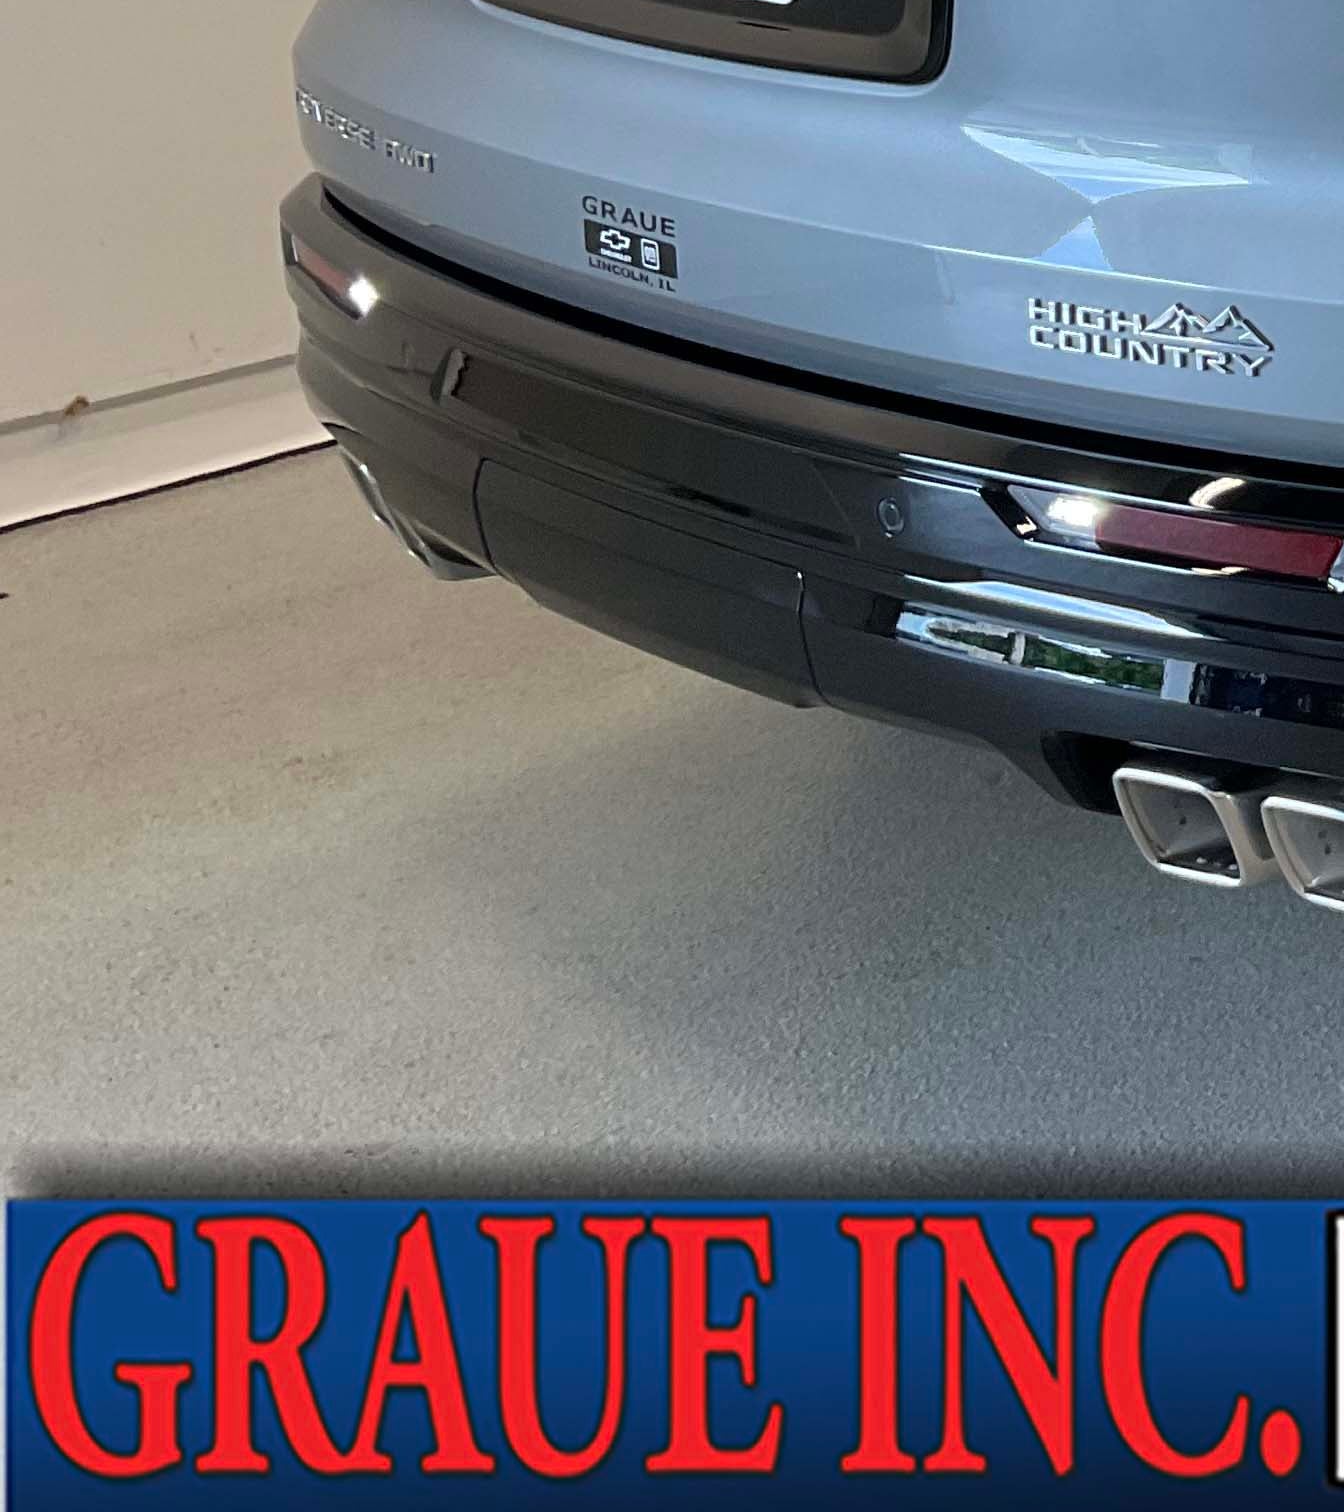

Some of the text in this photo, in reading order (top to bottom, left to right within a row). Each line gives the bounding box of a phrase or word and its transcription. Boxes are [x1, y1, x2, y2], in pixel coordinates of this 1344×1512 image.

[582, 195, 676, 238] GRAUE
[658, 278, 676, 292] IL
[1028, 298, 1148, 336] HIGH
[1029, 325, 1273, 377] COUNTRY
